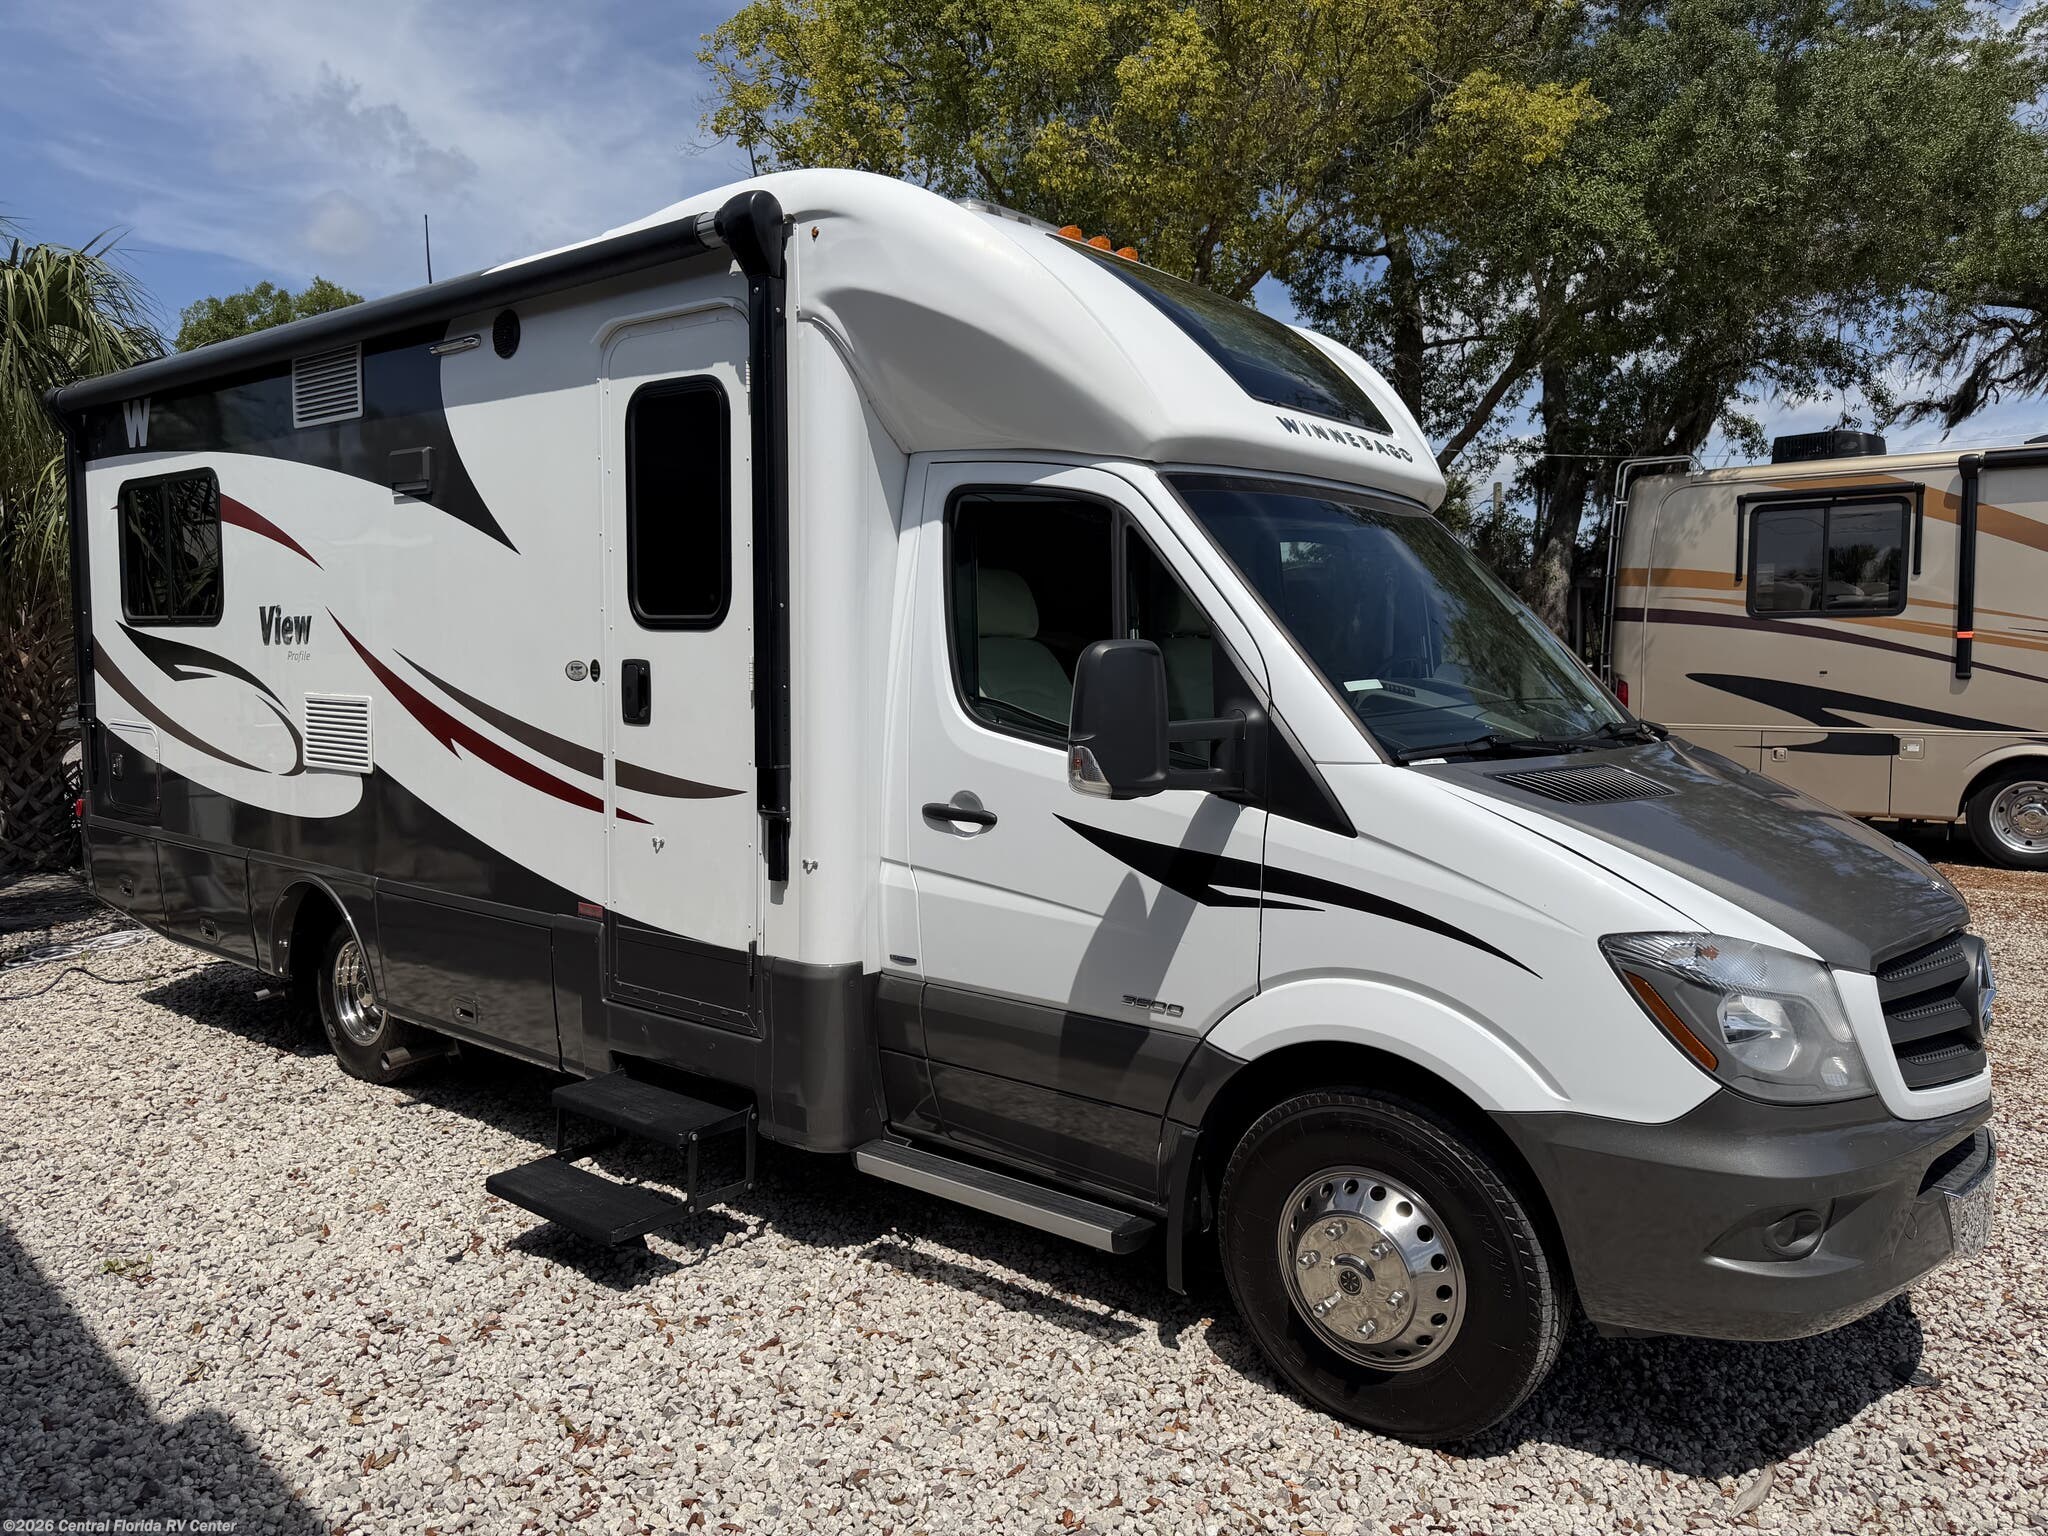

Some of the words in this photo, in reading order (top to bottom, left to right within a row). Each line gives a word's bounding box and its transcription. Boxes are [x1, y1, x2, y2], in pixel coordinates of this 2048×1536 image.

[122, 398, 151, 448] W
[1275, 415, 1413, 463] WINNEBAGO
[259, 605, 312, 646] View
[287, 651, 311, 663] Profile
